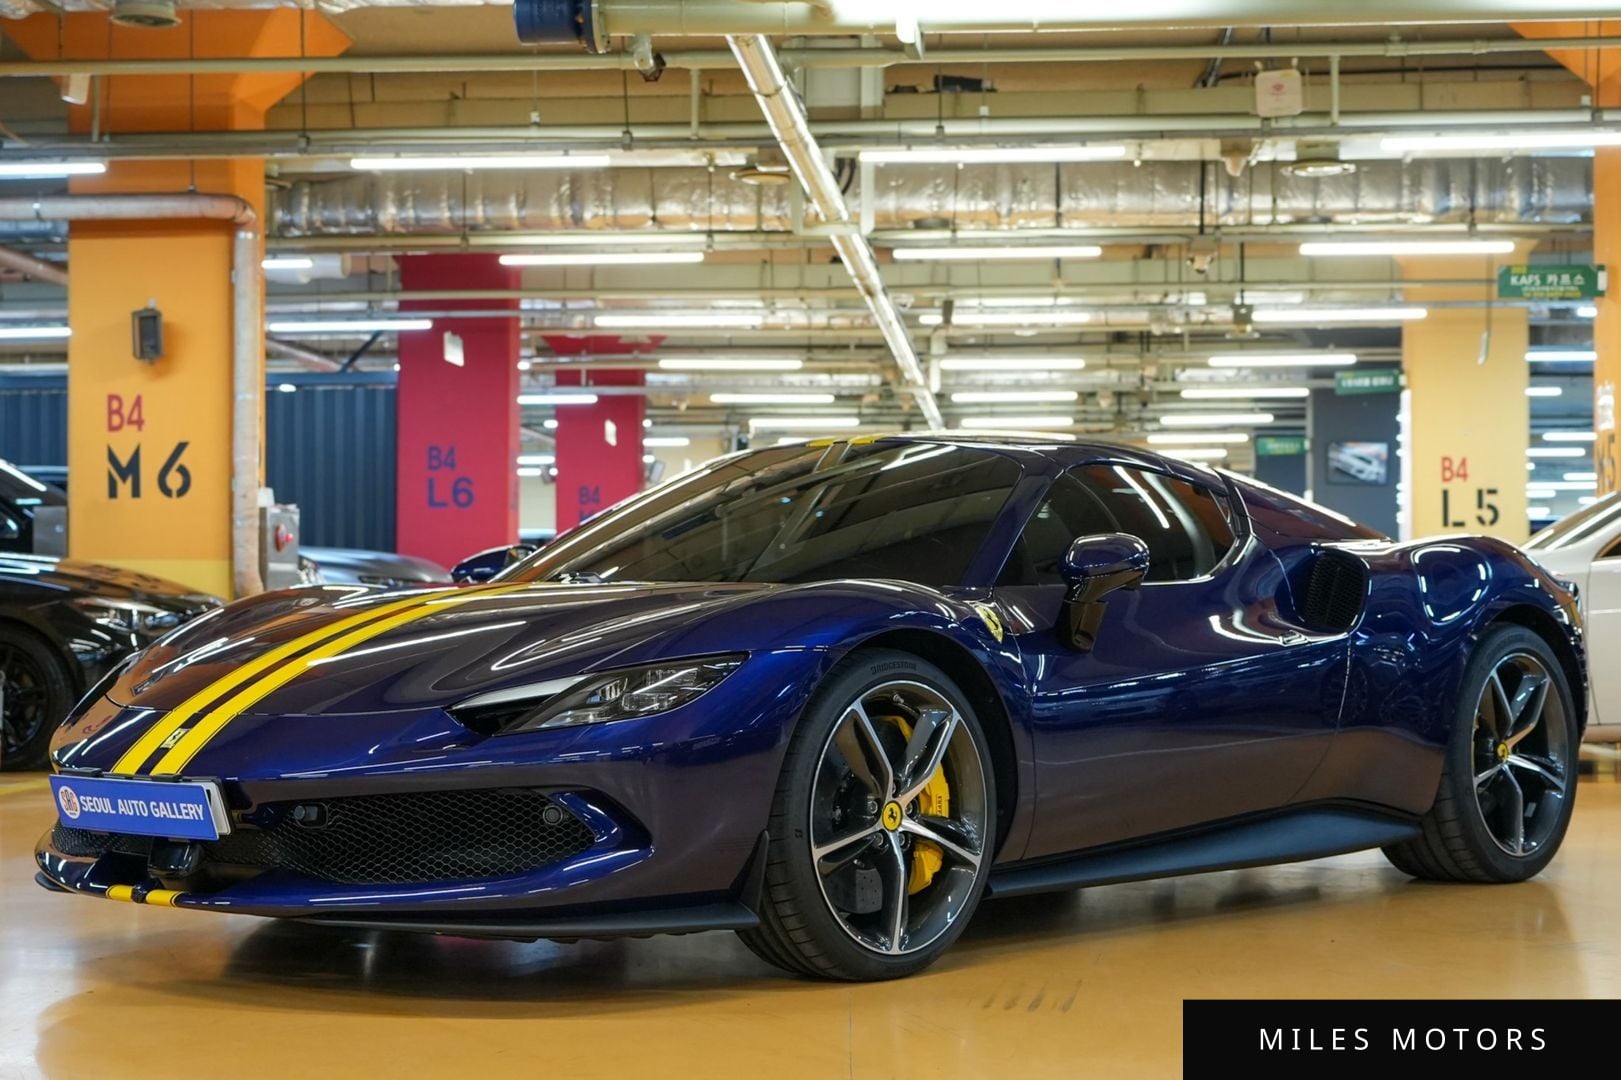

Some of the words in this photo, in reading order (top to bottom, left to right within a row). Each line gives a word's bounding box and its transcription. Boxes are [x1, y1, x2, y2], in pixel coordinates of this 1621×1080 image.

[107, 394, 145, 432] B4
[428, 445, 456, 471] B4
[1441, 456, 1468, 482] B4
[80, 795, 116, 815] SEOUL
[118, 799, 149, 817] AUTO
[151, 802, 204, 821] GALLERY
